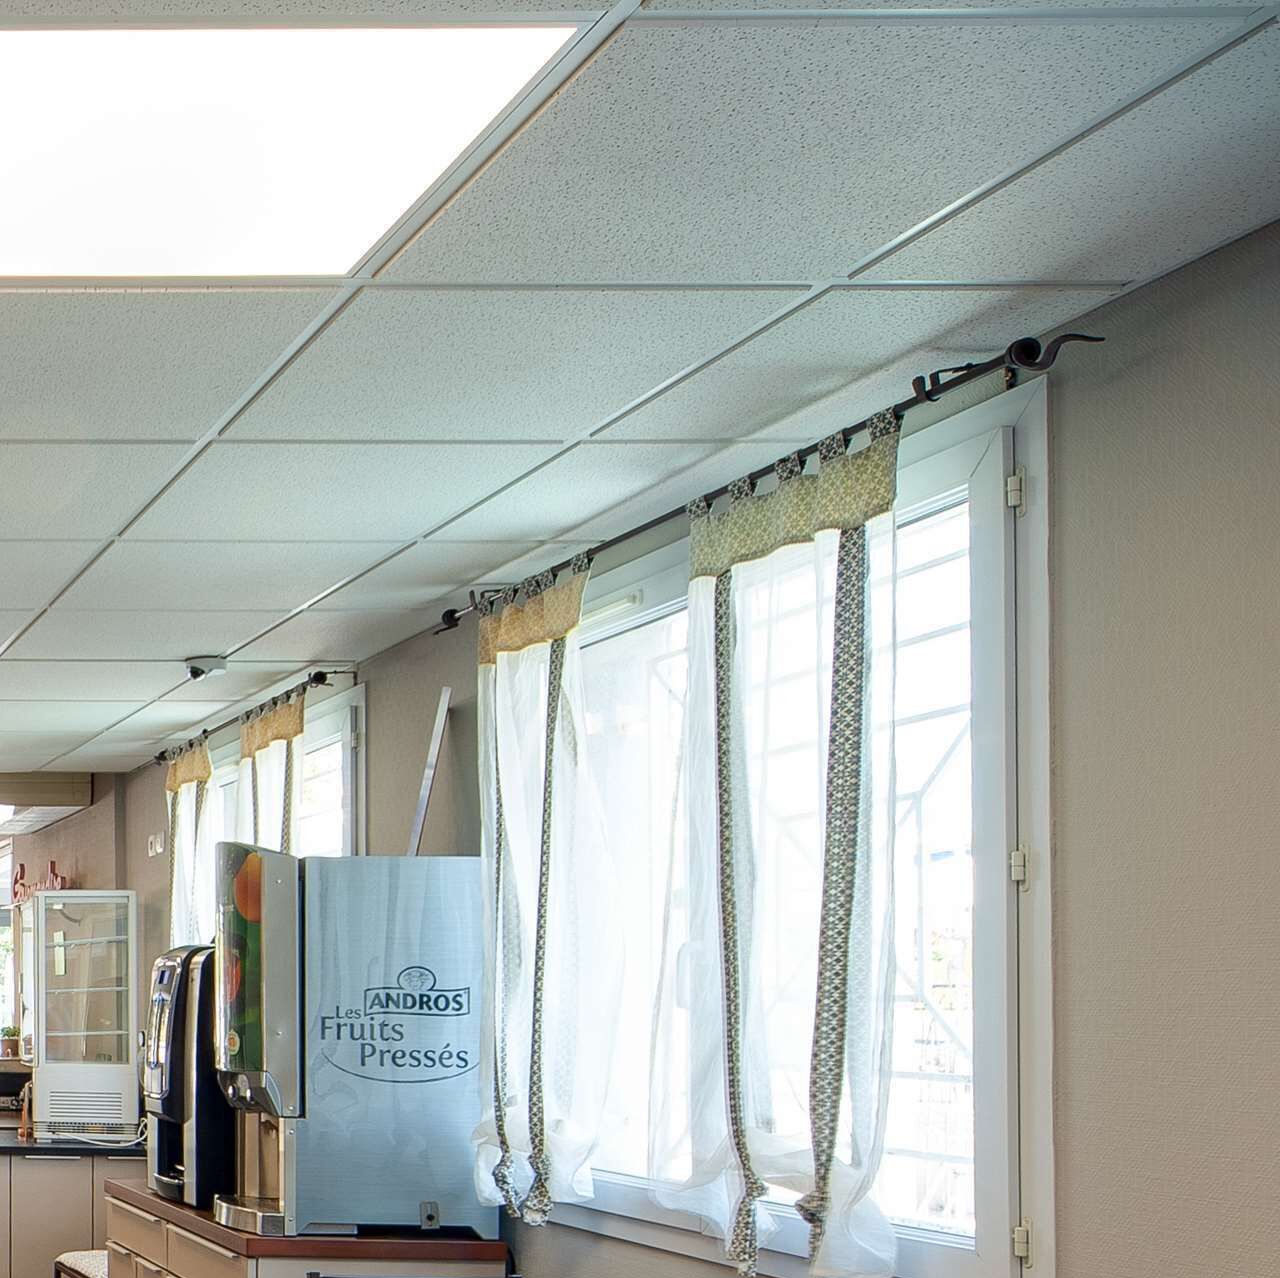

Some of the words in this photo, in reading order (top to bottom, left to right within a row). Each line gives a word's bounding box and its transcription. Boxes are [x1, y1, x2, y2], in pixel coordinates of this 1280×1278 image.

[336, 1005, 362, 1020] Les
[369, 993, 464, 1012] ANDROS
[320, 1016, 405, 1042] Fruits
[360, 1043, 469, 1069] Pressés
